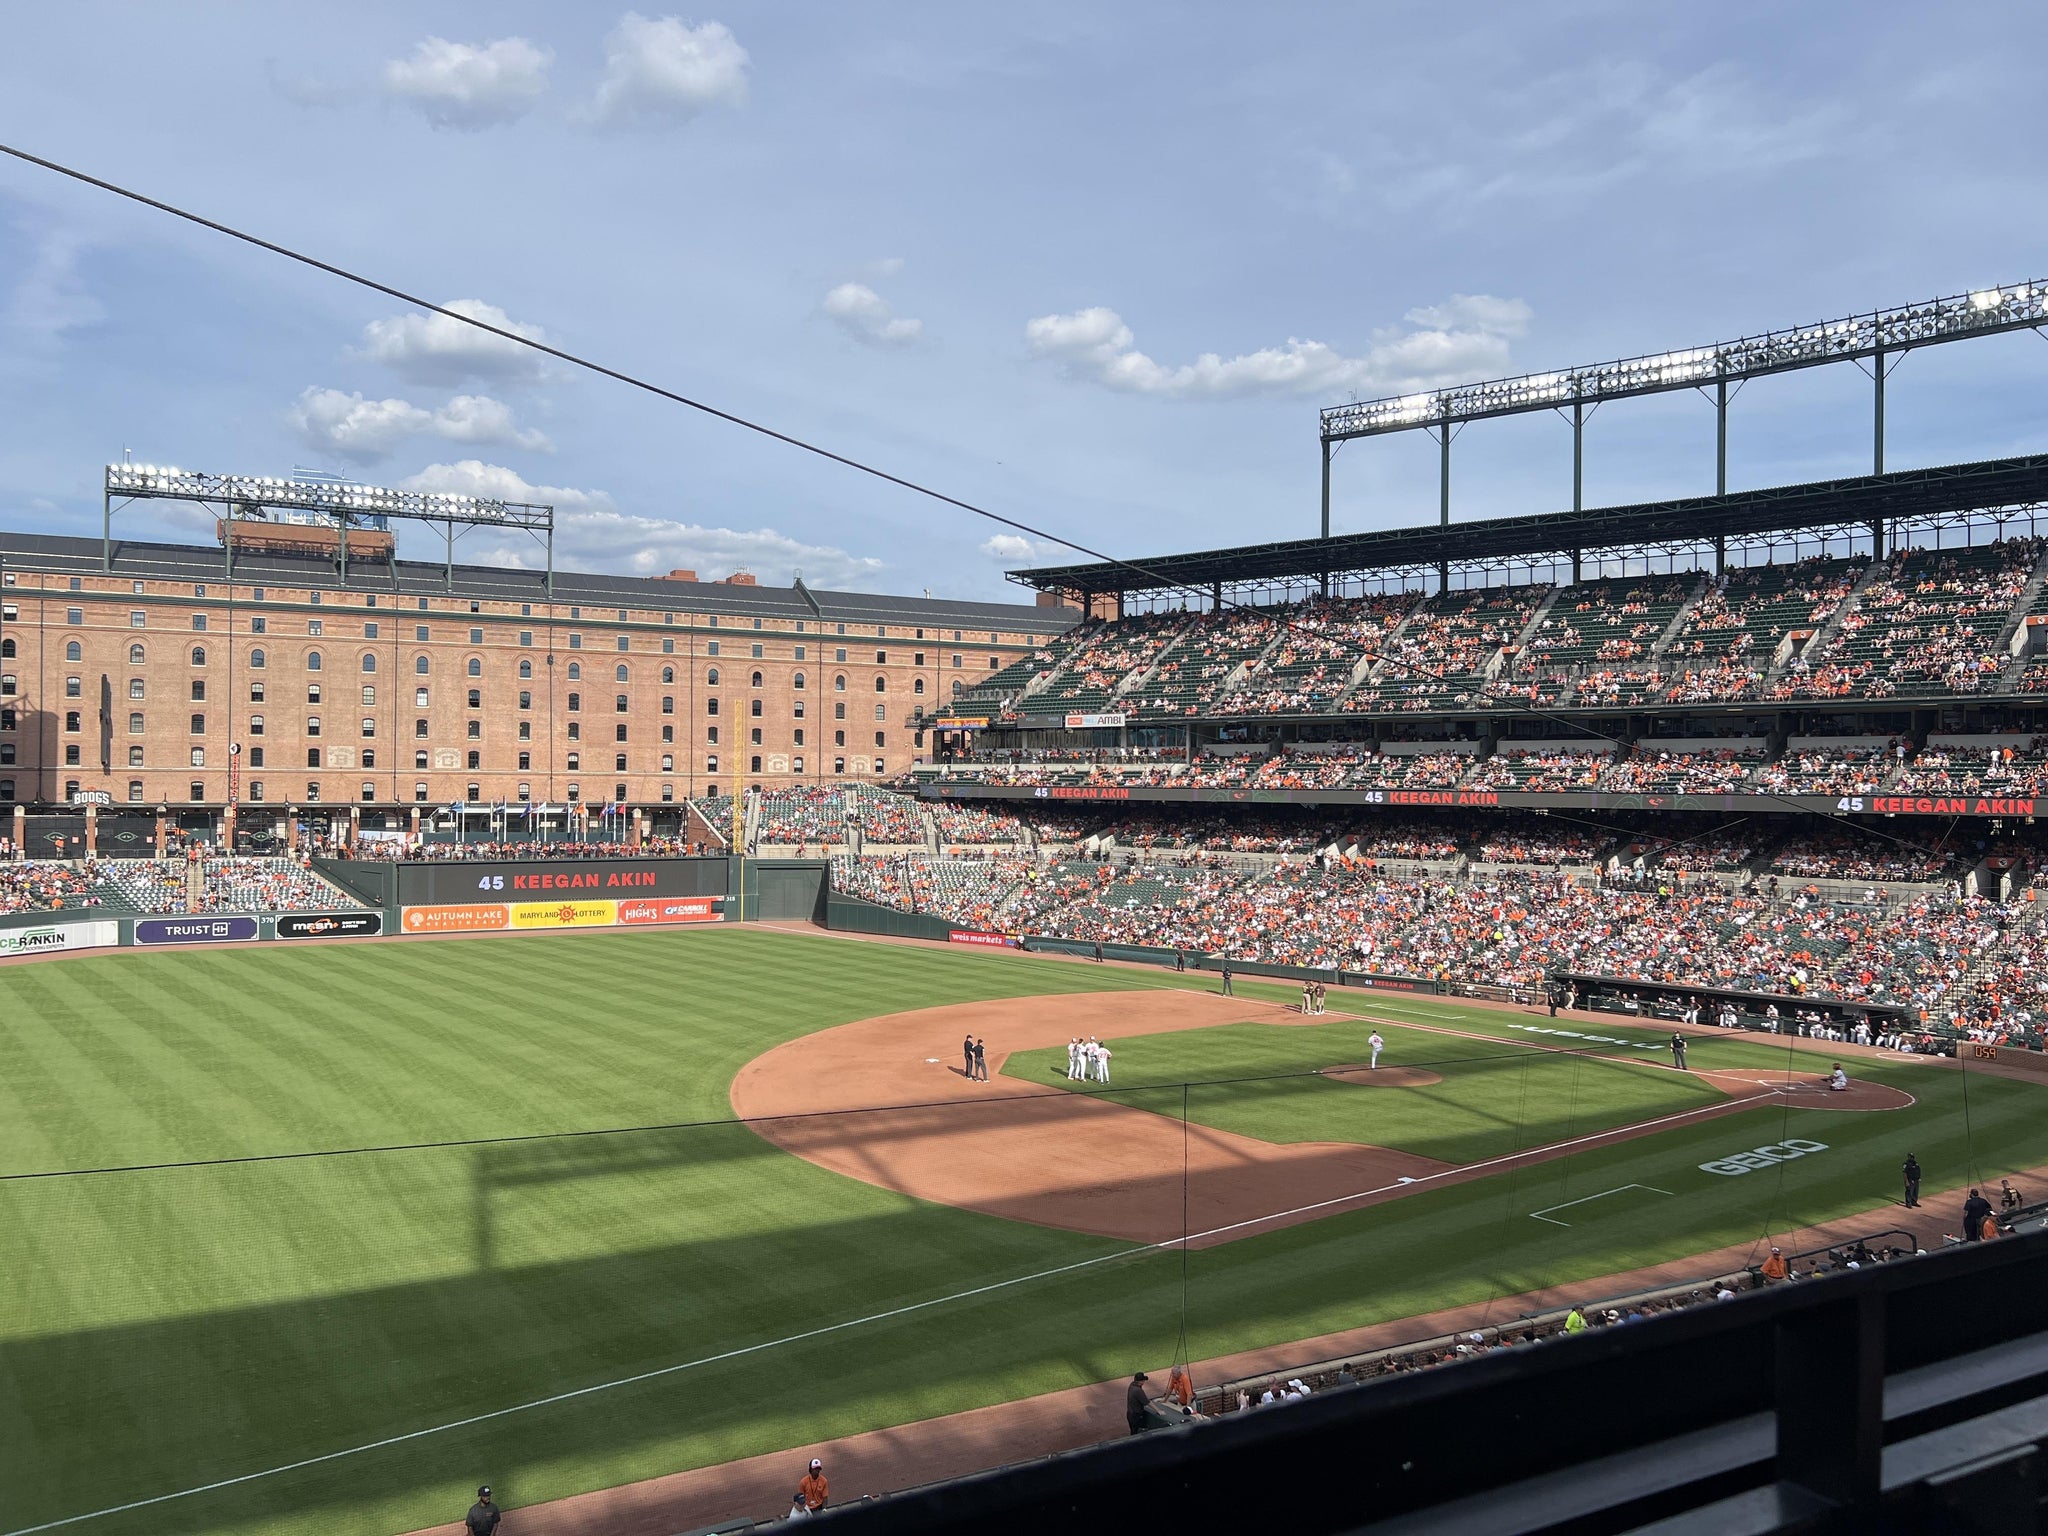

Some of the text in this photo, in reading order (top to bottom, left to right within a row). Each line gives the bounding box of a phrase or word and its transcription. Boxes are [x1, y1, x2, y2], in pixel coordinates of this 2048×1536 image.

[74, 791, 110, 805] BOOG'S
[1034, 788, 1130, 798] 45 KEEGAN AKIN
[1365, 791, 1499, 804] 45 KEEGAN AKIN
[1837, 798, 2034, 815] 45 KEEGAN AKIN
[478, 872, 656, 890] 45 KEEGAN AKIN
[427, 910, 503, 921] AUTUMN LAKE
[520, 911, 559, 919] MARYLAND
[576, 909, 606, 917] LOTTERY
[625, 907, 658, 921] HIGH'S
[260, 917, 275, 925] 370
[165, 925, 210, 936] TRUIST
[19, 933, 65, 947] RANKIN
[951, 933, 969, 941] weis
[970, 935, 1003, 945] markets
[1697, 1139, 1830, 1176] GEICO
